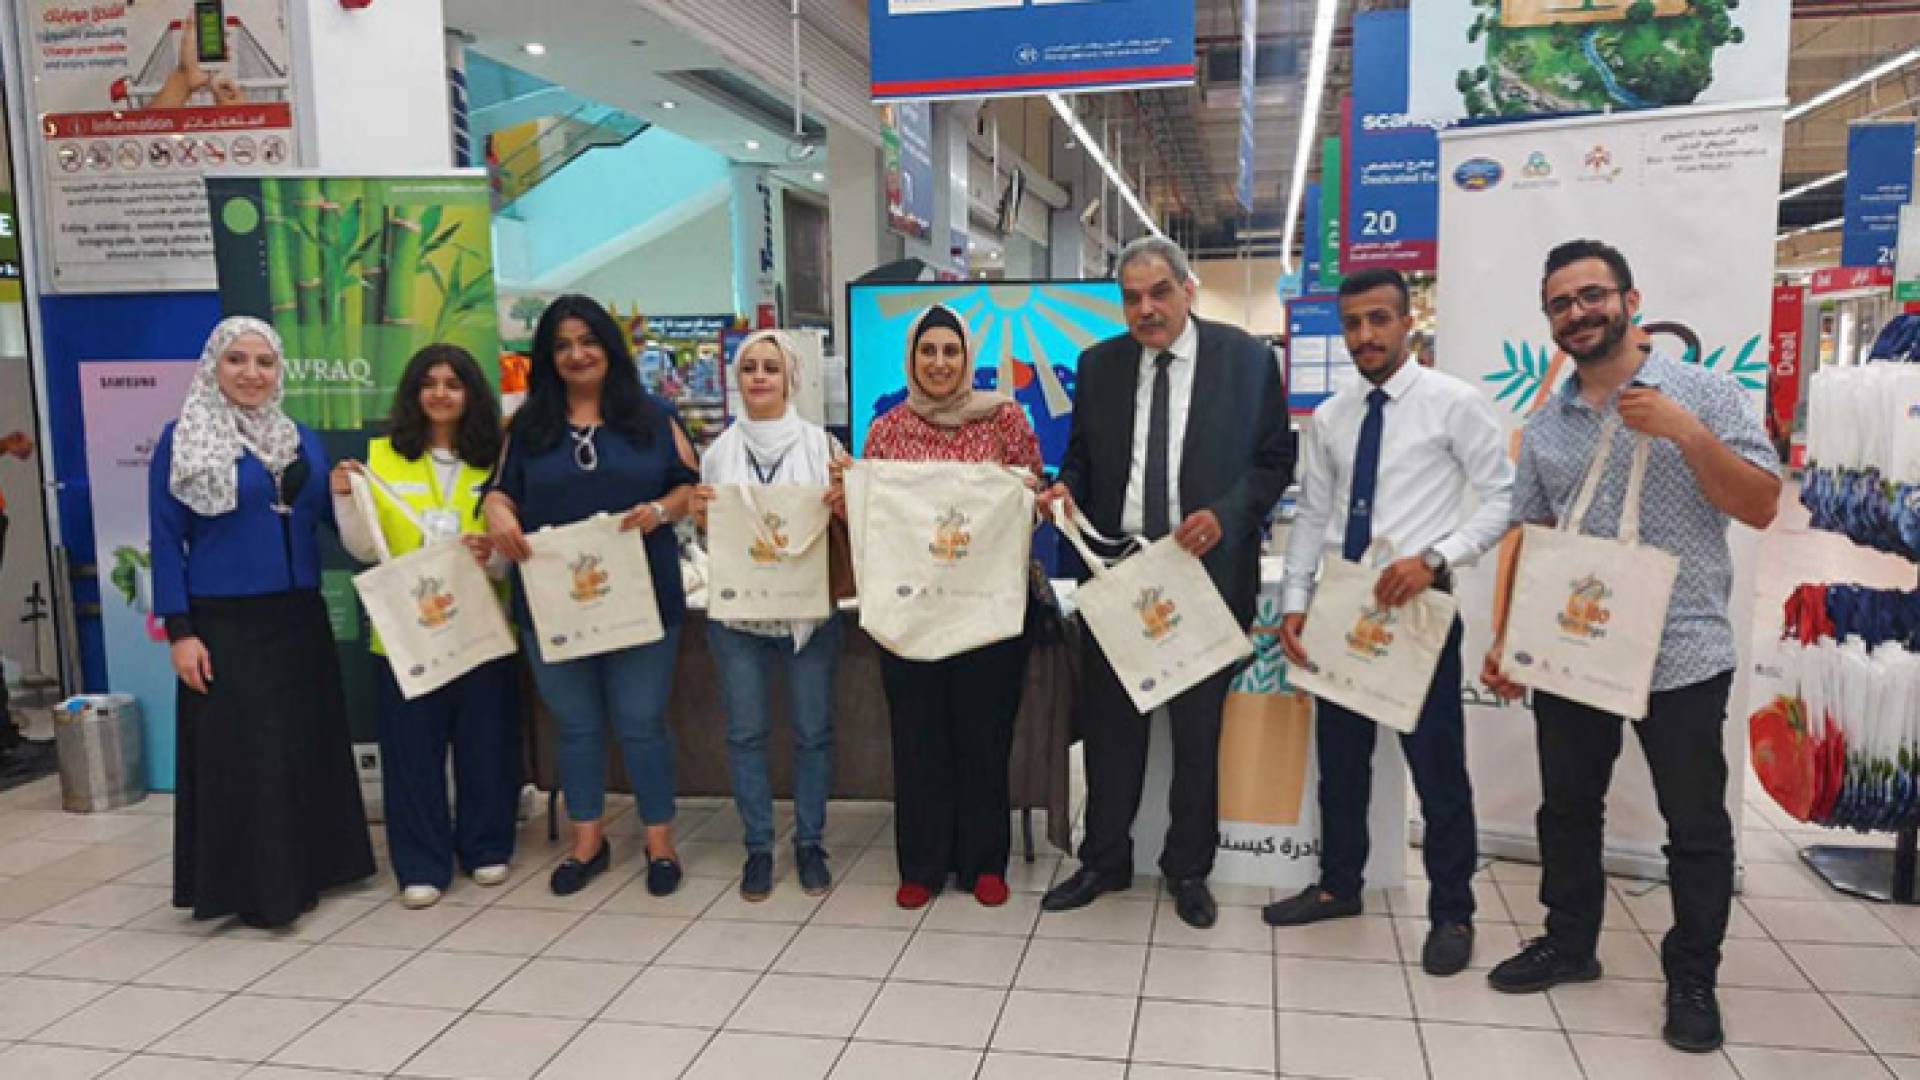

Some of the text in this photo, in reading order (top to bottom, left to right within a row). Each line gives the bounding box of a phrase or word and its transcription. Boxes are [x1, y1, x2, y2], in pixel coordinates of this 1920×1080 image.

[91, 117, 174, 131] Information
[1361, 210, 1397, 236] 20
[99, 376, 157, 389] SAMSUNG
